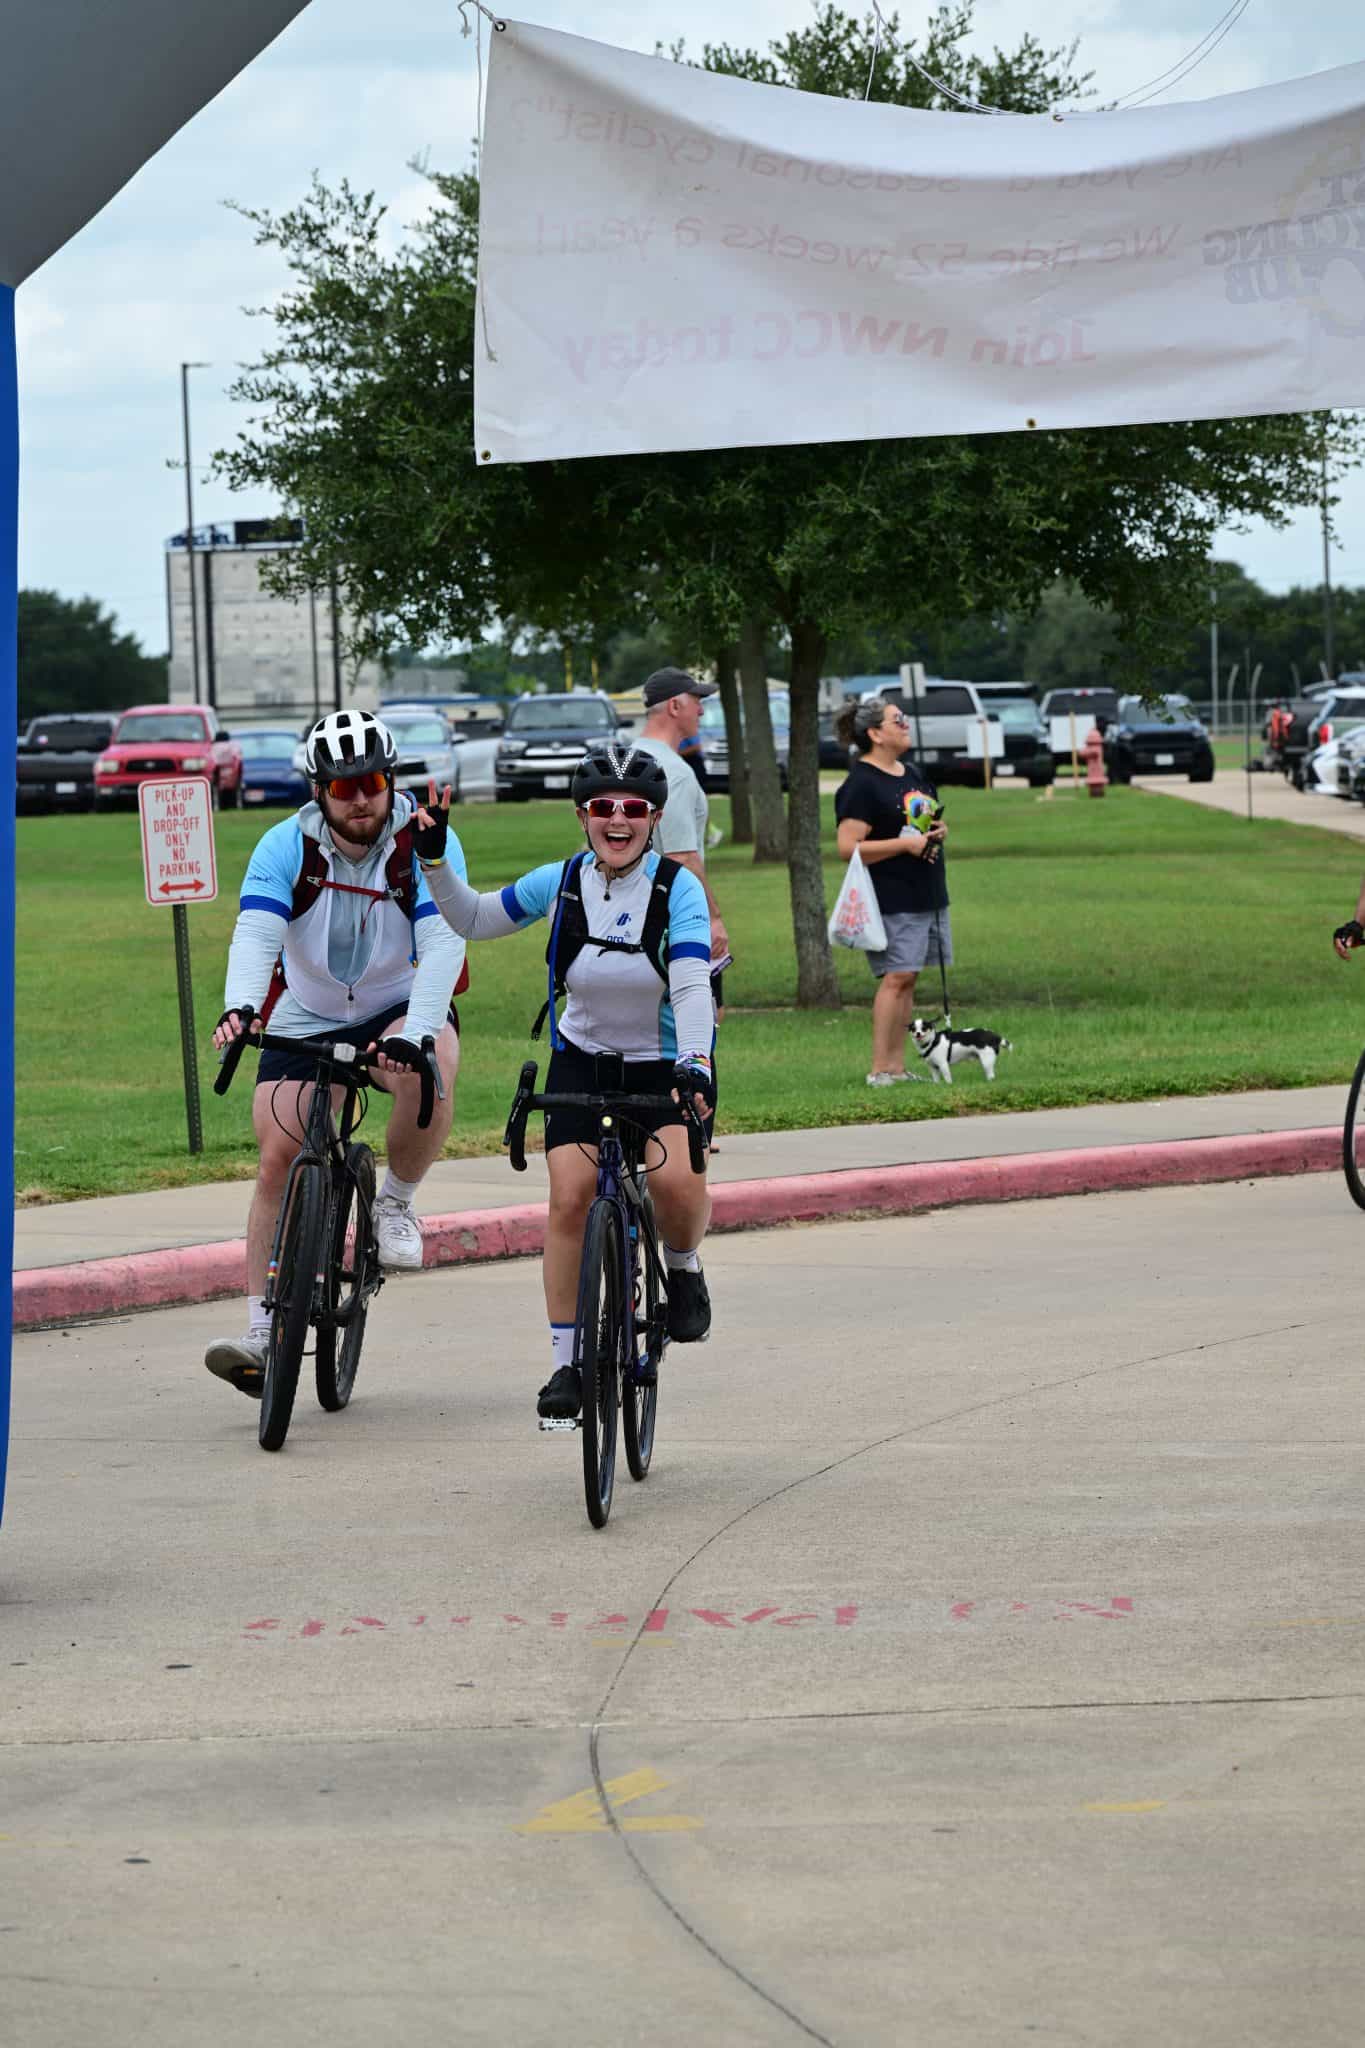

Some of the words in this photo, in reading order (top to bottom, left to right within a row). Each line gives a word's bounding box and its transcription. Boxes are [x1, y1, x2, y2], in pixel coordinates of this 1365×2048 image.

[155, 788, 195, 803] PICK-UP
[166, 803, 186, 817] AND
[153, 816, 200, 833] DROP-OFF
[165, 831, 190, 847] ONLY
[172, 847, 186, 861] NO
[159, 861, 201, 877] PARKING
